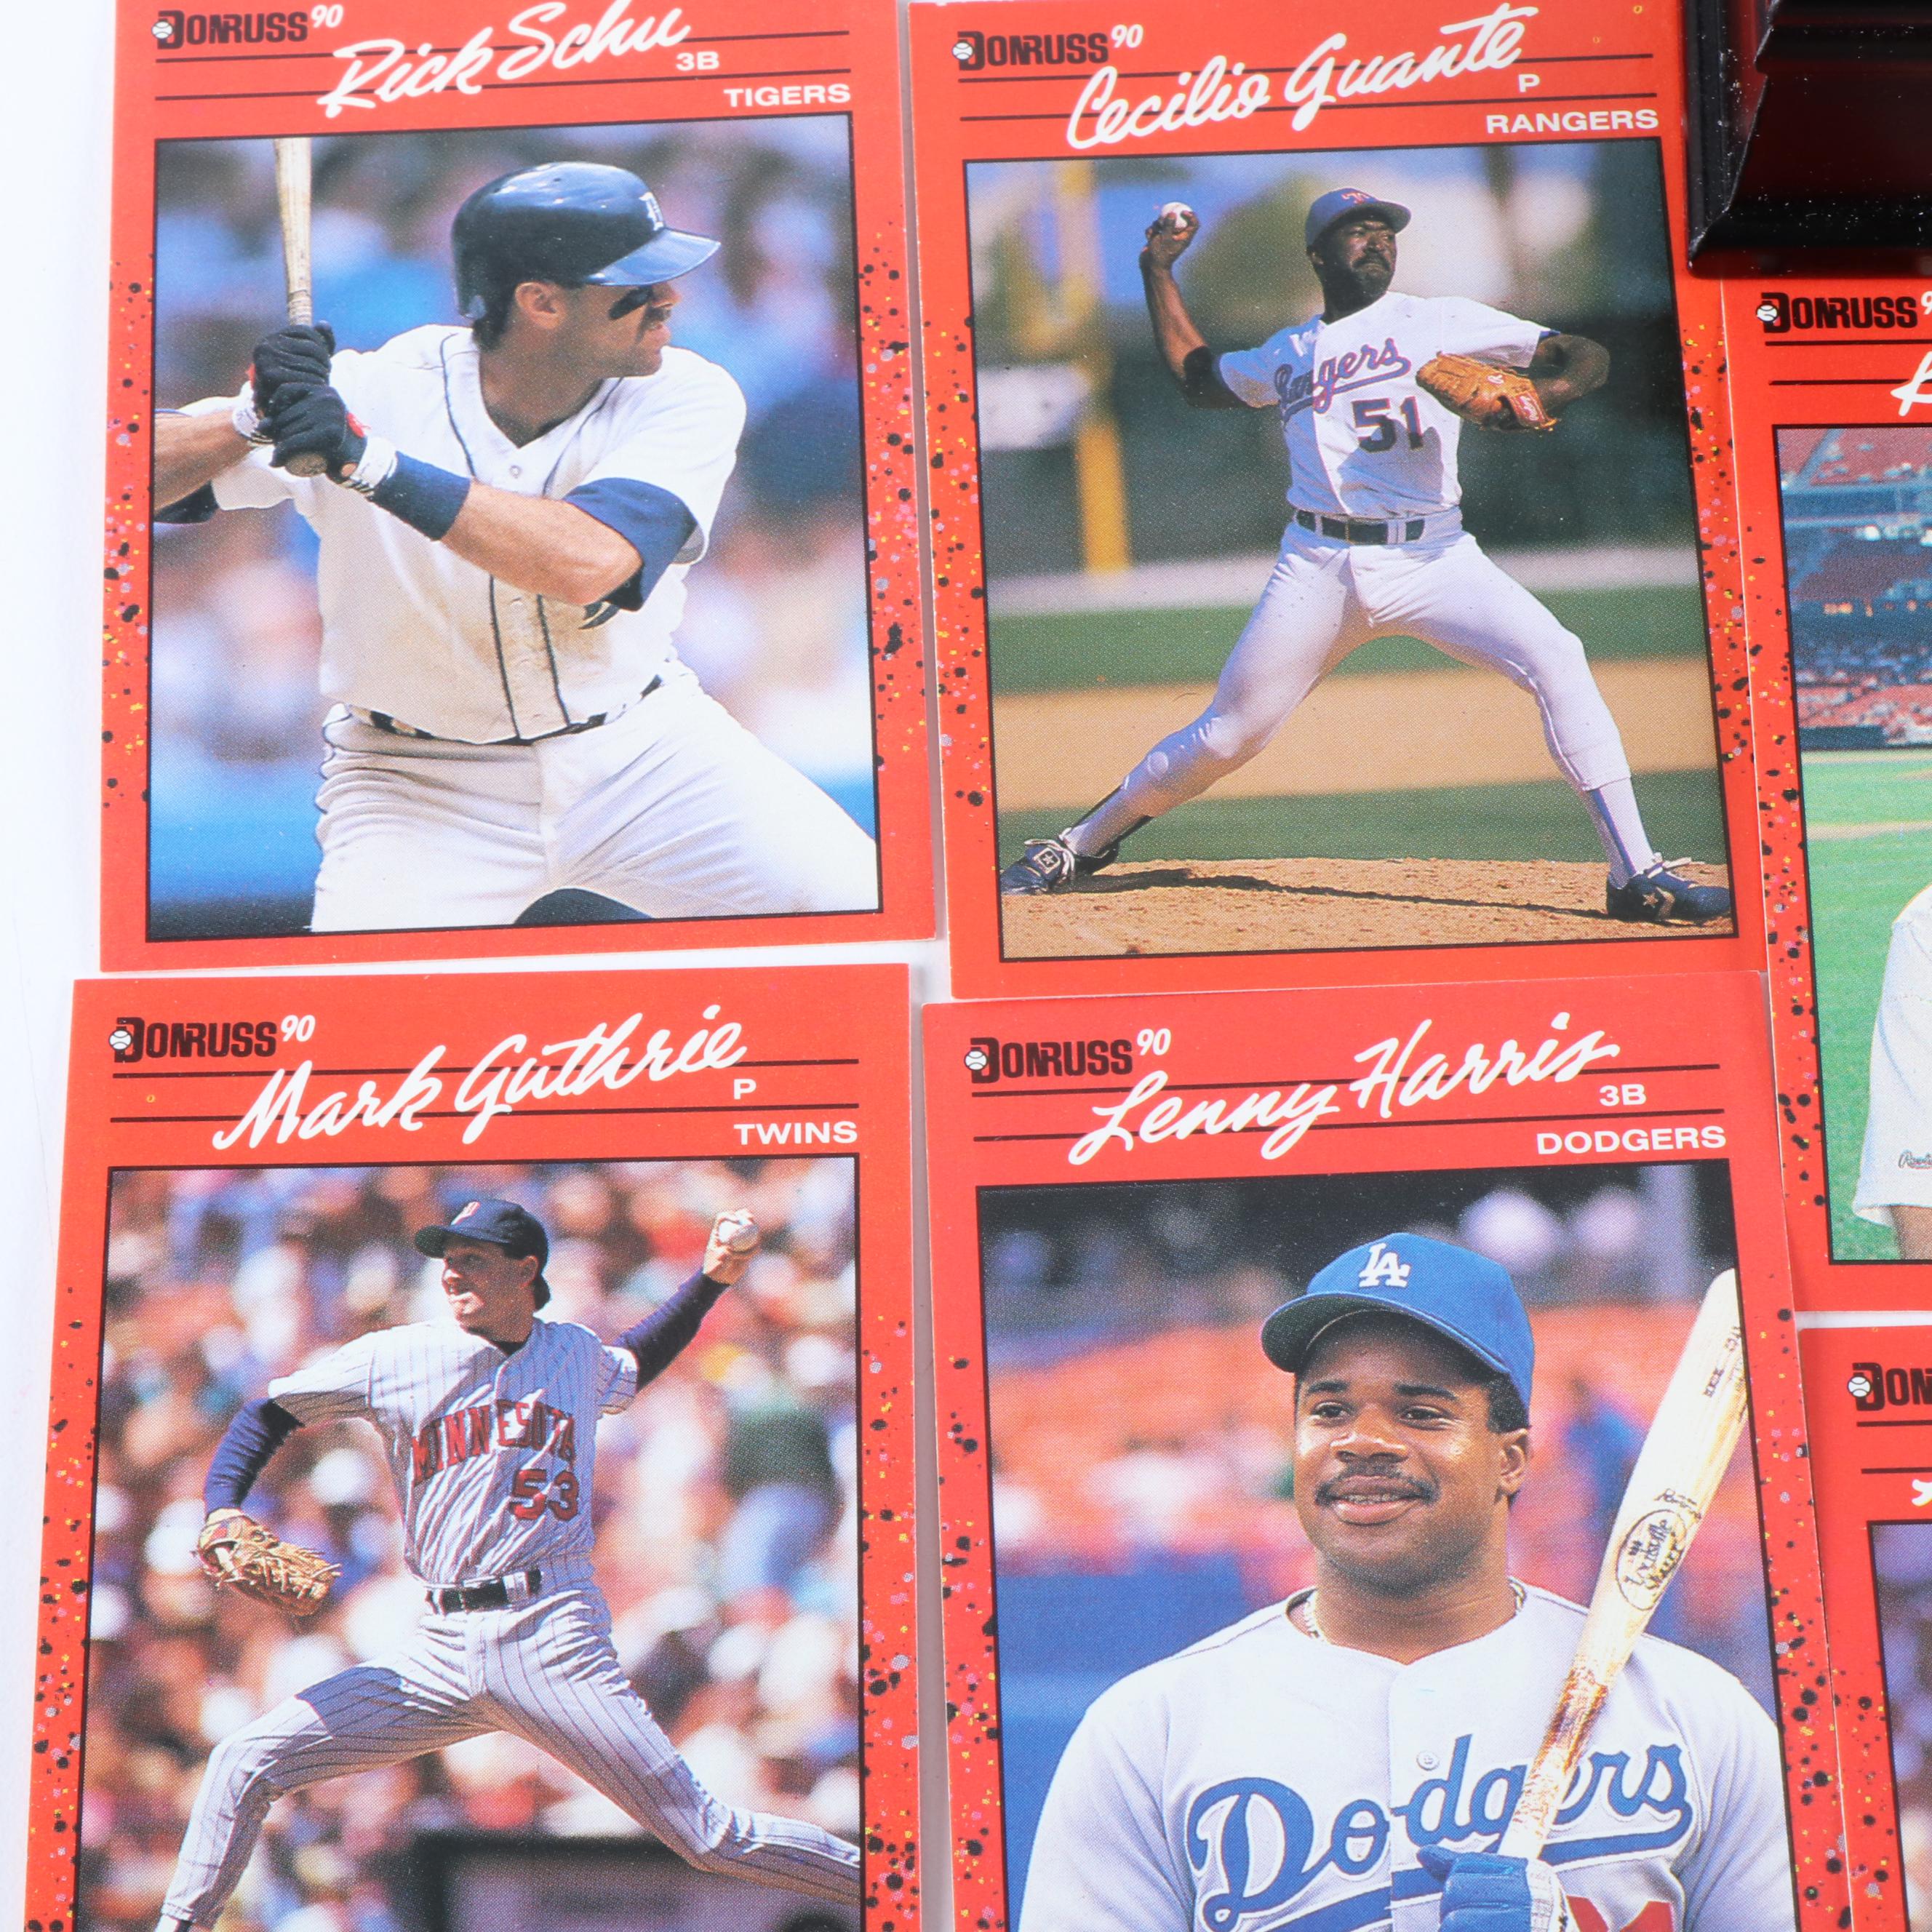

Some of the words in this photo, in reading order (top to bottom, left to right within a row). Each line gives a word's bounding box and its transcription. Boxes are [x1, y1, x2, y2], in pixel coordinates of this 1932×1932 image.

[153, 10, 308, 49] DONRUSS
[311, 4, 344, 28] 90
[952, 31, 1109, 71] DONRUSS
[1111, 24, 1143, 48] 90
[316, 26, 494, 119] Rick
[497, 0, 692, 80] Schu
[676, 51, 719, 71] 3B
[1066, 55, 1269, 149] Cecilio
[1285, 2, 1539, 132] Guante
[723, 83, 851, 108] TIGERS
[1519, 74, 1540, 92] P
[1487, 109, 1658, 134] RANGERS
[1756, 292, 1917, 333] DONRUSS
[1352, 397, 1424, 452] 51
[109, 1017, 277, 1063] DONRUSS
[281, 1015, 316, 1042] 90
[964, 1037, 1133, 1084] DONRUSS
[1136, 1028, 1171, 1055] 90
[212, 1045, 447, 1150] Mark
[454, 1005, 748, 1144] Guthrie
[733, 1078, 757, 1100] P
[1068, 1070, 1340, 1165] Lenny
[1349, 1012, 1621, 1119] Harris
[1600, 1084, 1646, 1106] 3B
[733, 1120, 858, 1145] TWINS
[1537, 1125, 1726, 1154] DODGERS
[1358, 1242, 1411, 1288] LA
[508, 1469, 580, 1522] 53
